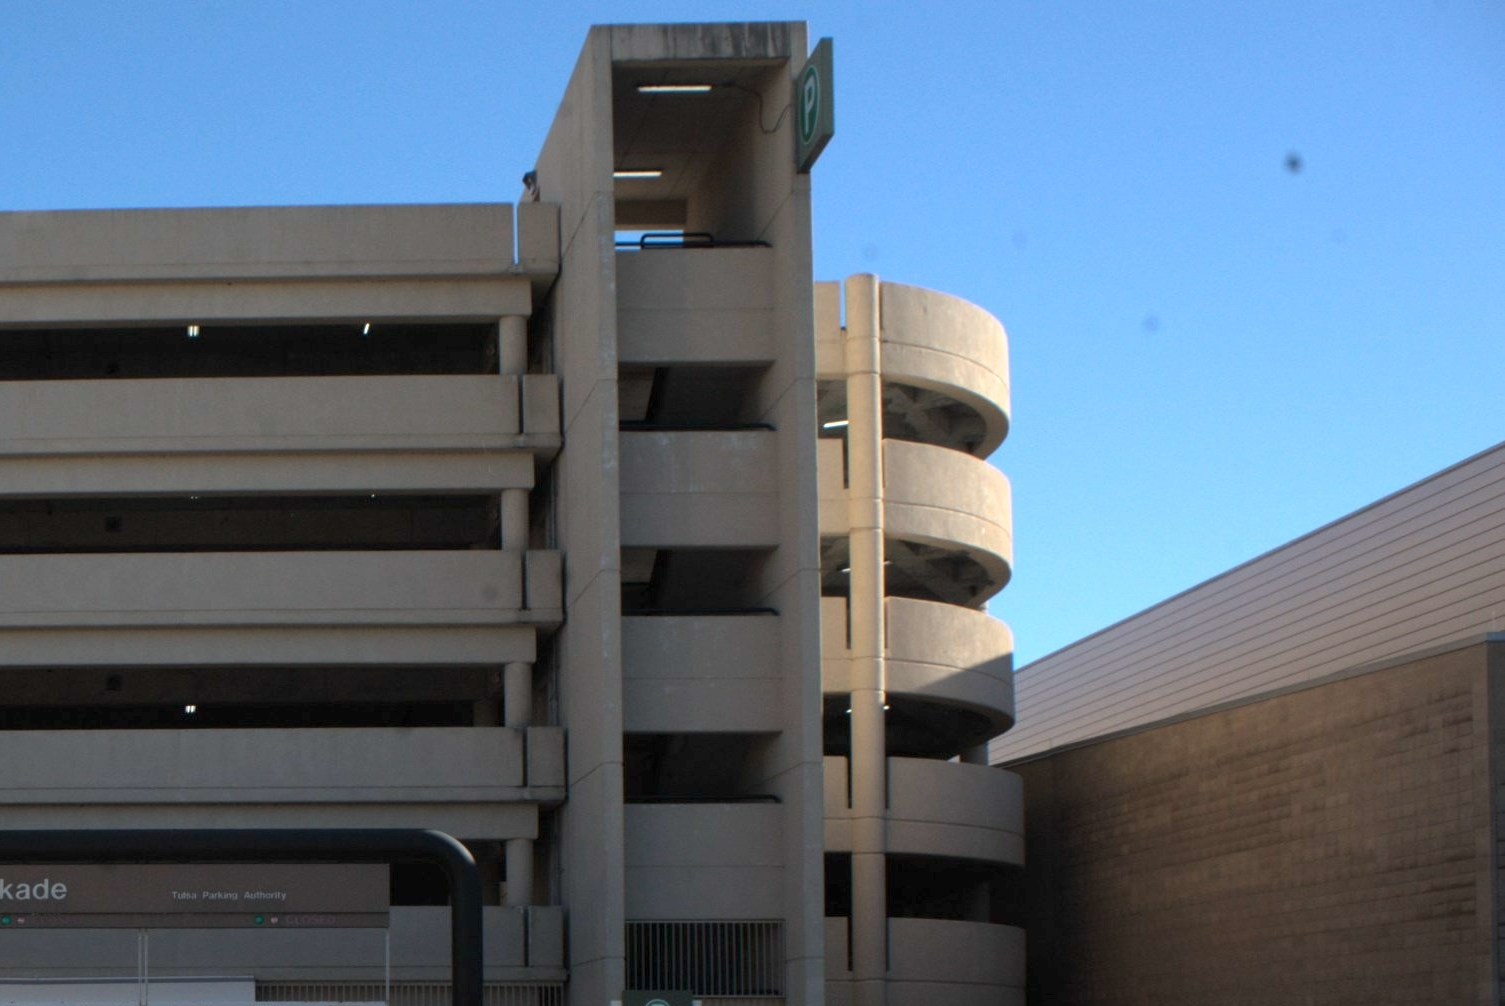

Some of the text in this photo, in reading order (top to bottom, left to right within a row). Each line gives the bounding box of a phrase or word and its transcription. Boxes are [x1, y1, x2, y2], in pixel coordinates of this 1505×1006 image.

[804, 75, 815, 136] P
[172, 891, 287, 901] Tulsa Parking Authority
[285, 914, 336, 925] CLOSED
